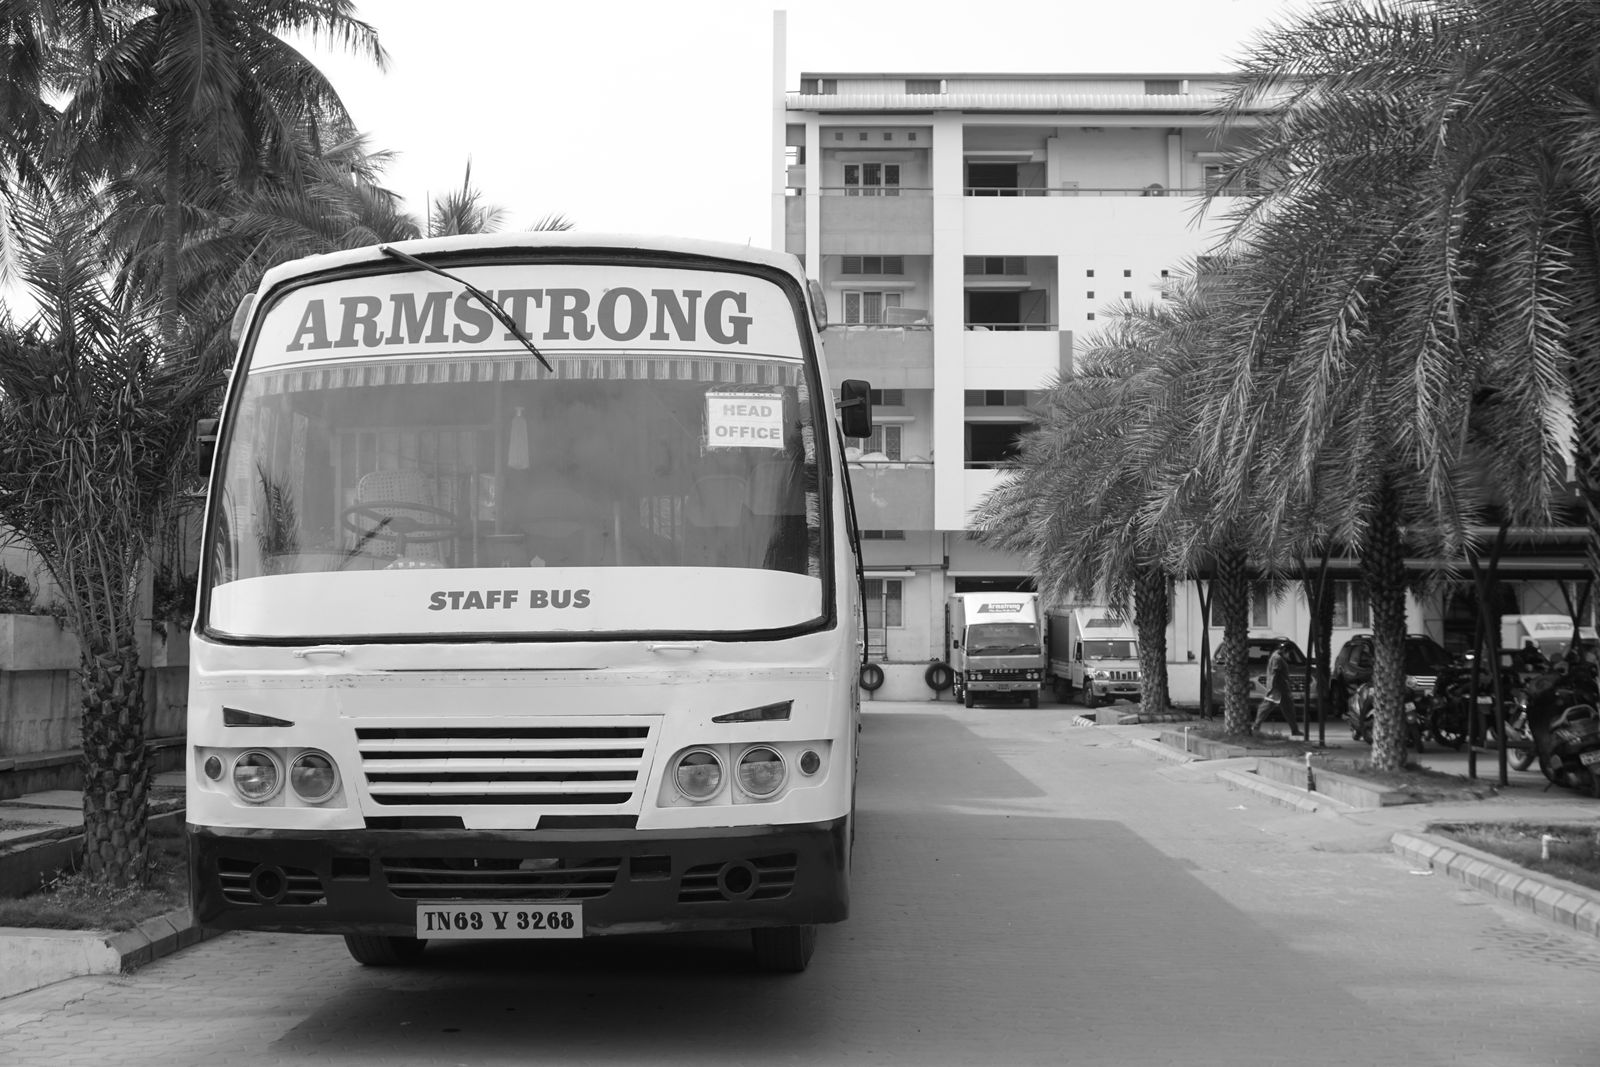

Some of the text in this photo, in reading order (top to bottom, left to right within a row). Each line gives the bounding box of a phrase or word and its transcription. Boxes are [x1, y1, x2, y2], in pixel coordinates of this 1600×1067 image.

[286, 287, 753, 352] ARMSTRONG
[723, 405, 772, 417] HEAD
[715, 426, 780, 439] OFFICE
[428, 589, 590, 611] STAFF BUS
[424, 912, 483, 931] TN63
[517, 912, 574, 930] 3268
